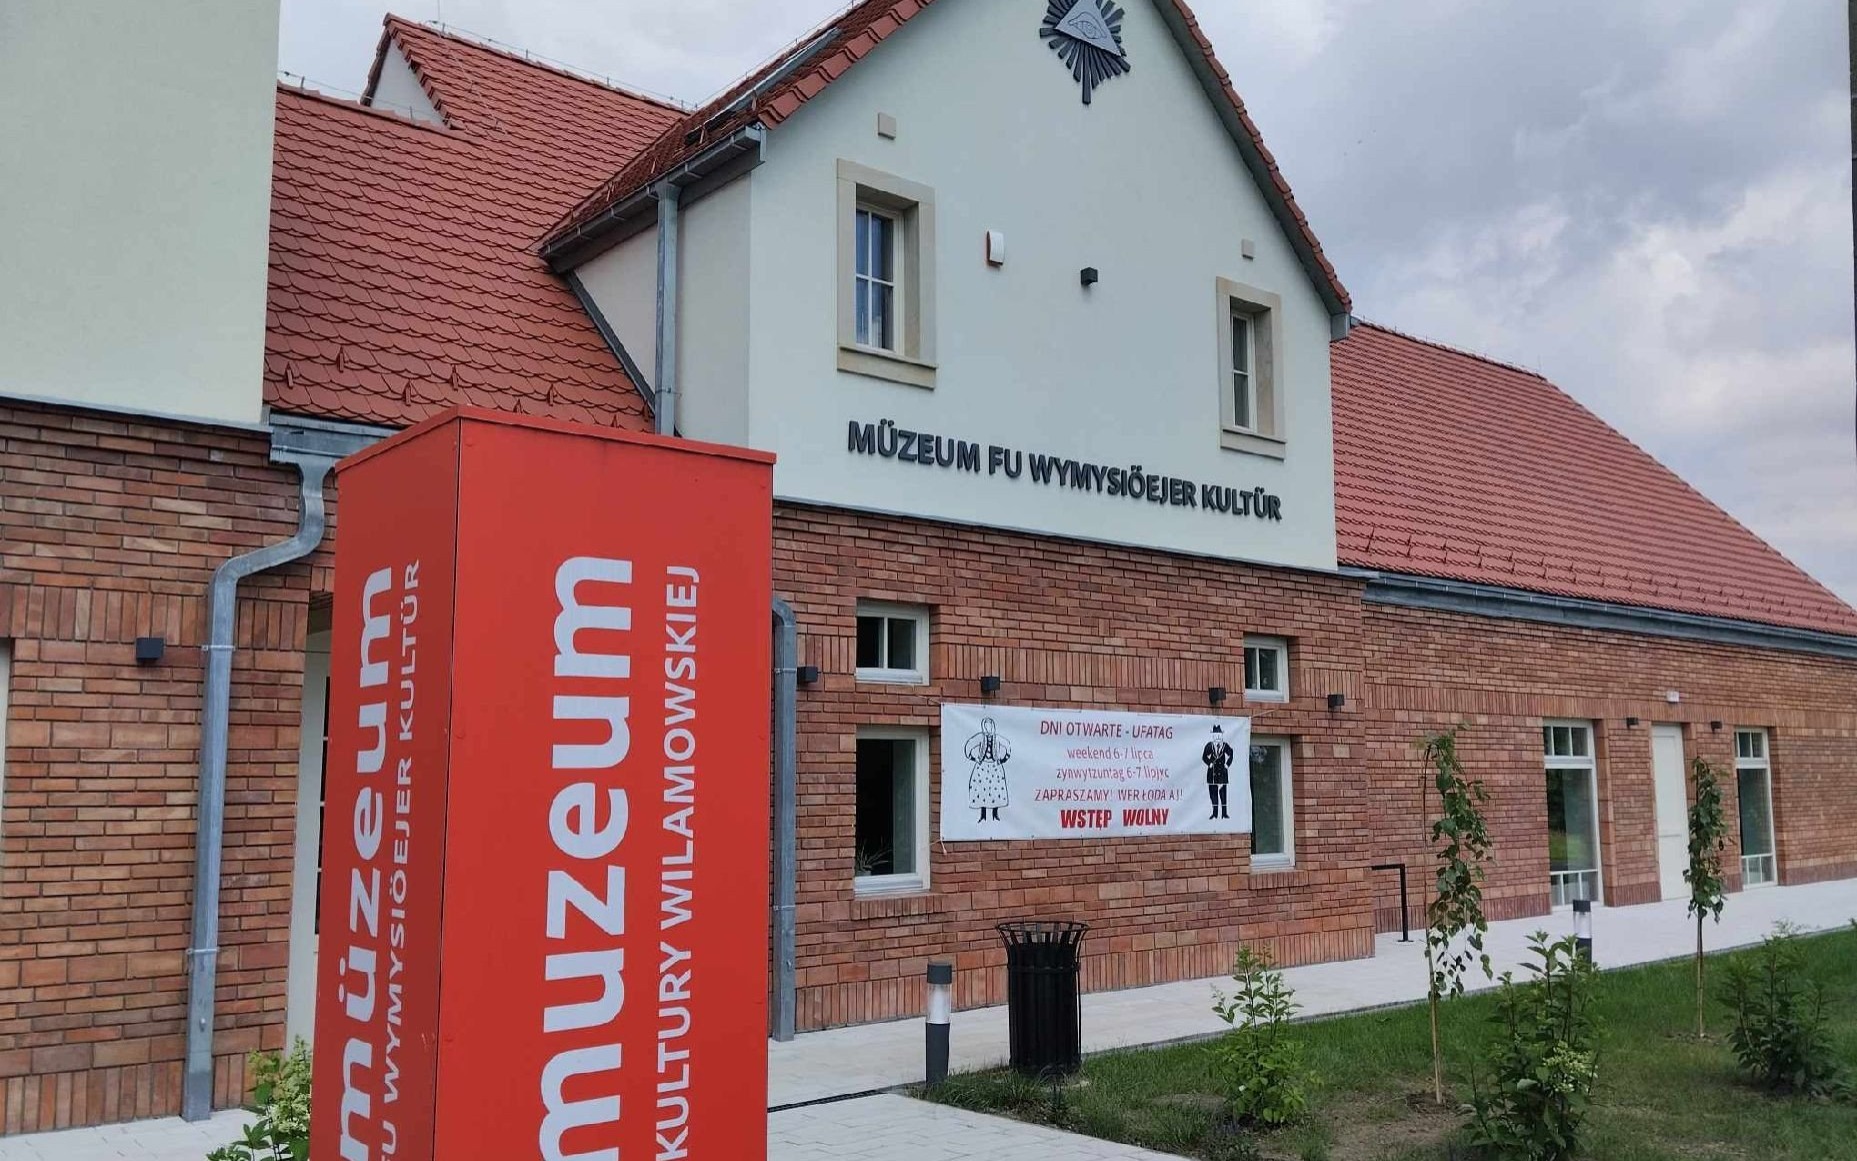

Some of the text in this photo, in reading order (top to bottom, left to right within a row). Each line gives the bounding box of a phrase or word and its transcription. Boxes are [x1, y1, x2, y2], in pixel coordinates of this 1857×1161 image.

[848, 418, 1282, 521] MÜZEUM FU WYMYSIÖEJER KULTÜR
[1040, 720, 1062, 736] DNI
[1066, 721, 1122, 738] OTWARTE
[1132, 725, 1173, 740] UFATAG
[1067, 746, 1111, 759] weekend
[1131, 746, 1154, 762] lipca
[1126, 766, 1142, 779] 6-7
[339, 566, 393, 1161] müzeum
[383, 757, 412, 1104] WYMYSIÖEJER
[399, 559, 420, 742] KULTÜR
[539, 555, 634, 1161] muzeum
[655, 565, 701, 1161] KULTURY WILAMOWSKIEJ
[1060, 808, 1170, 830] WSTĘP WOLNY
